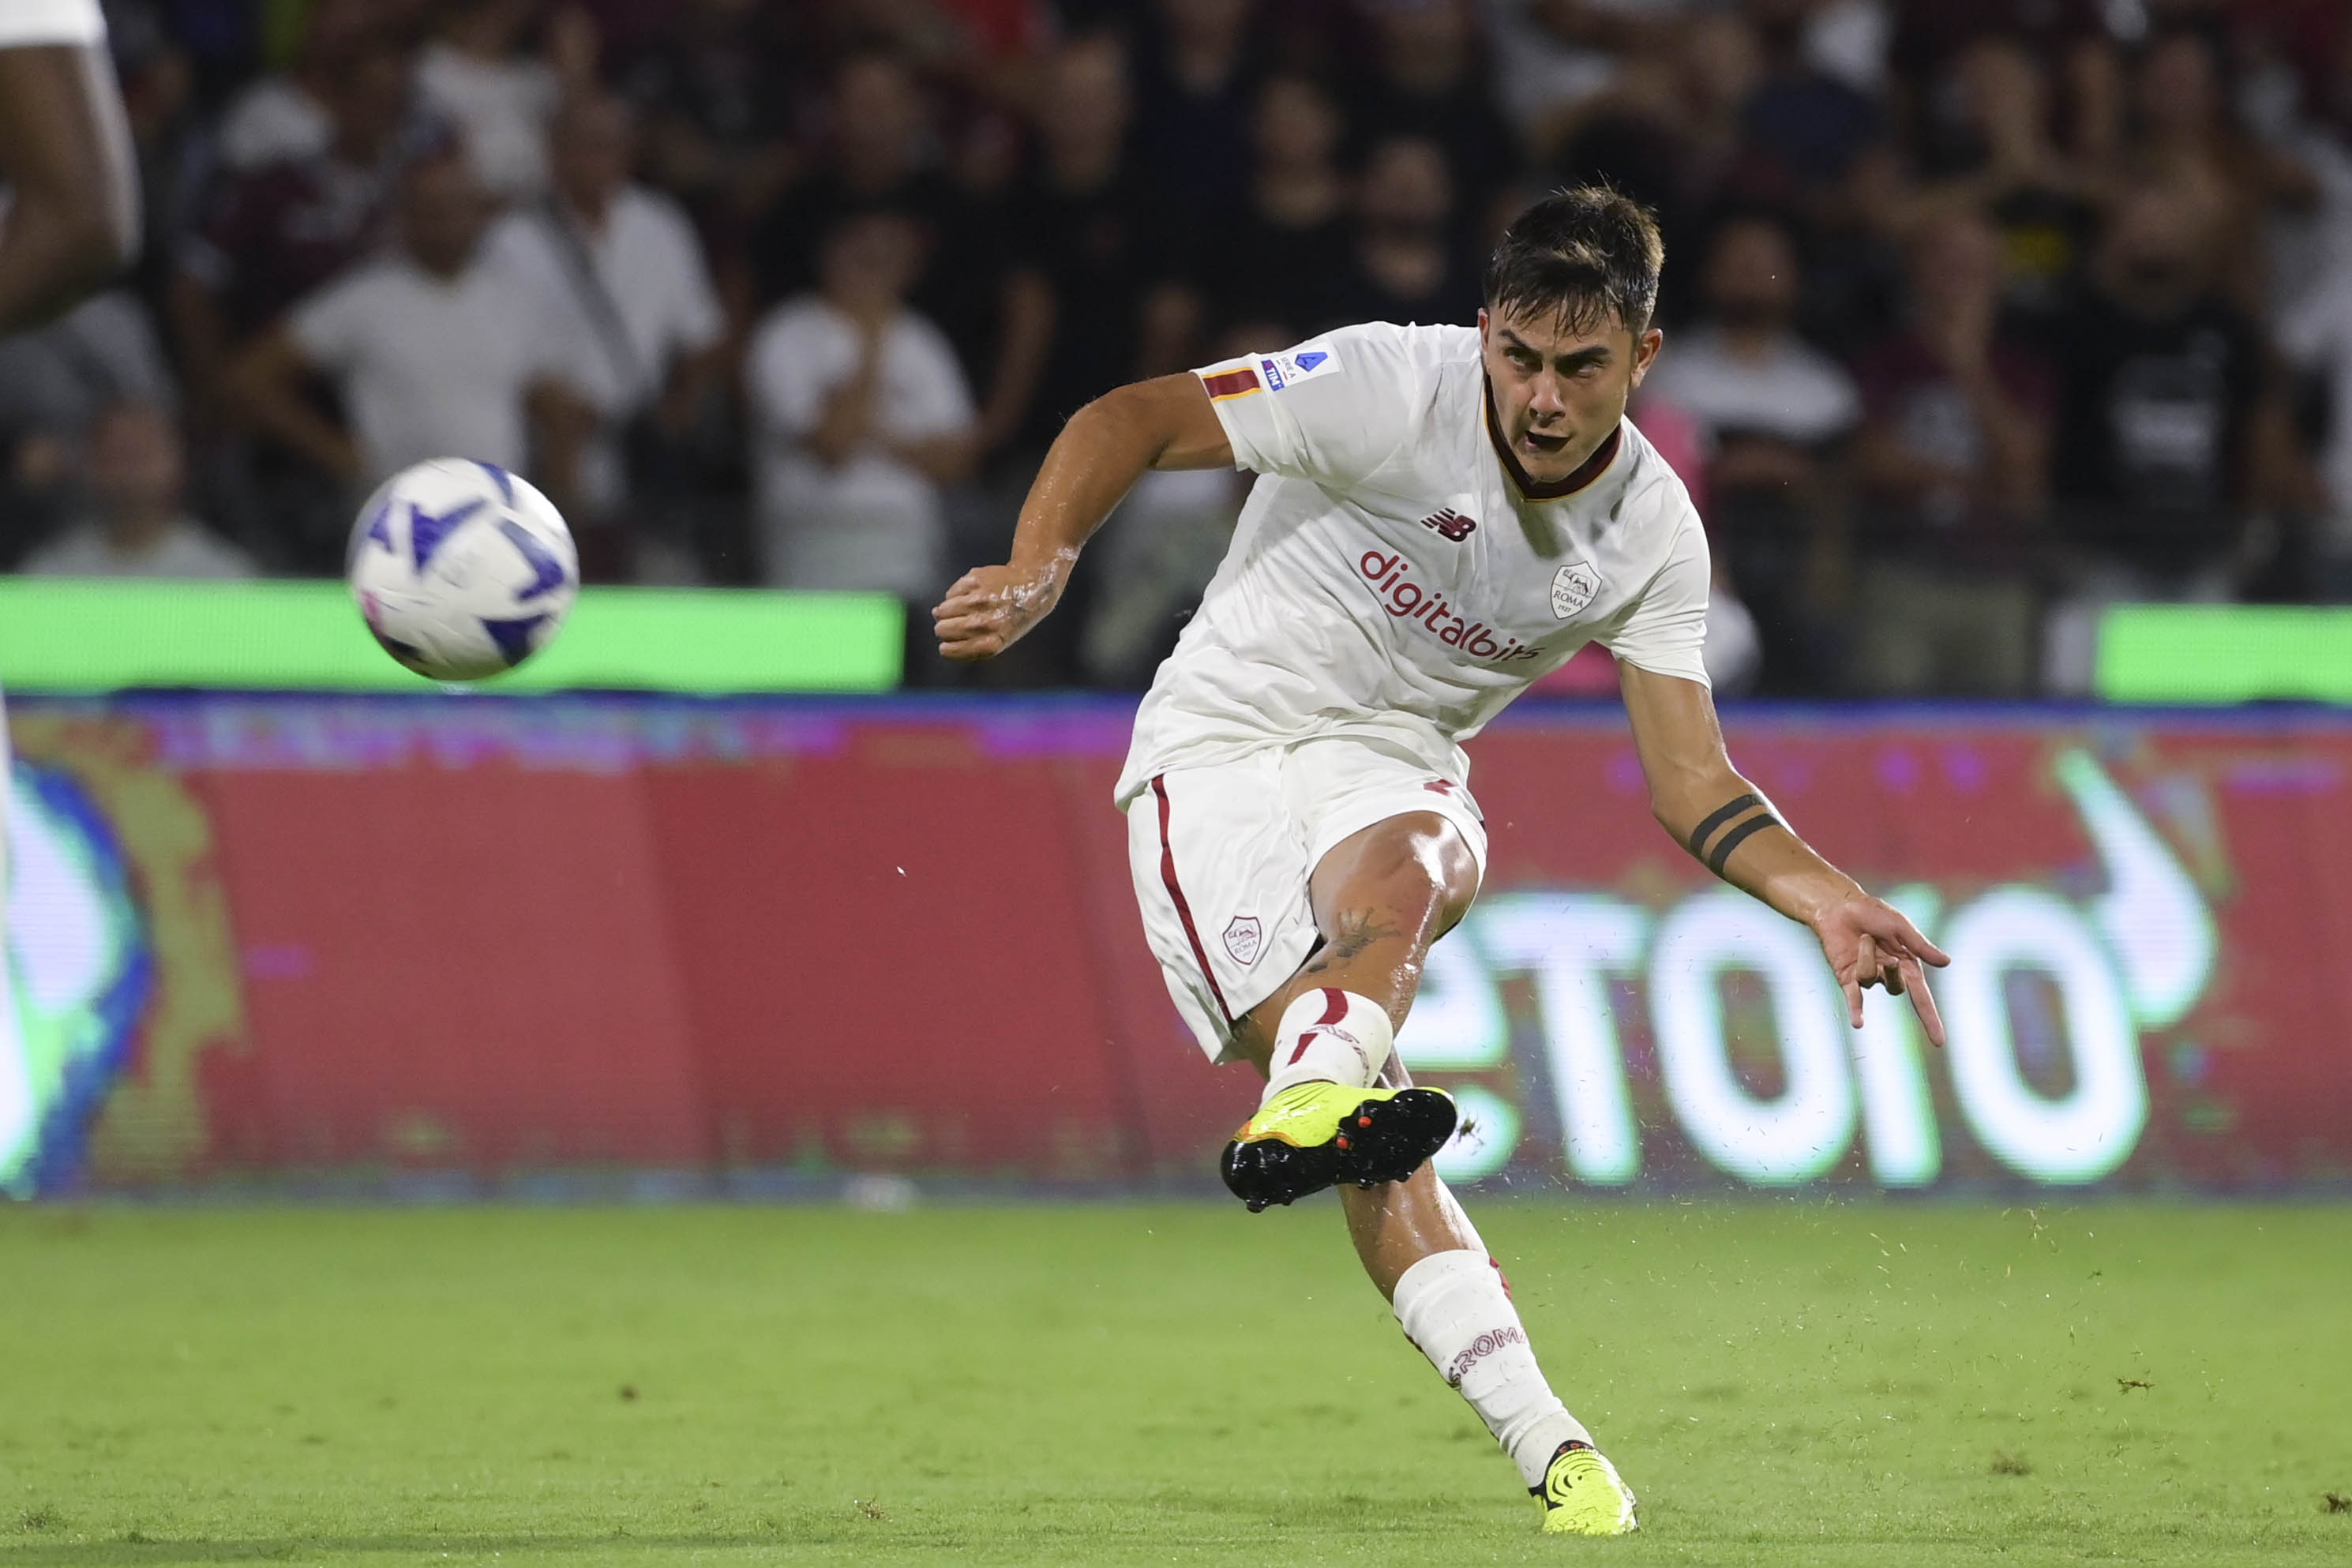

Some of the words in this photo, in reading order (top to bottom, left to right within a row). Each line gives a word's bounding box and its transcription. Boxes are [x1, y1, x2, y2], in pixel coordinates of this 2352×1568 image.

[1266, 366, 1281, 386] TIM
[1360, 550, 1545, 662] digitalbits
[1553, 589, 1584, 608] ROMA
[1234, 940, 1258, 955] ROMA
